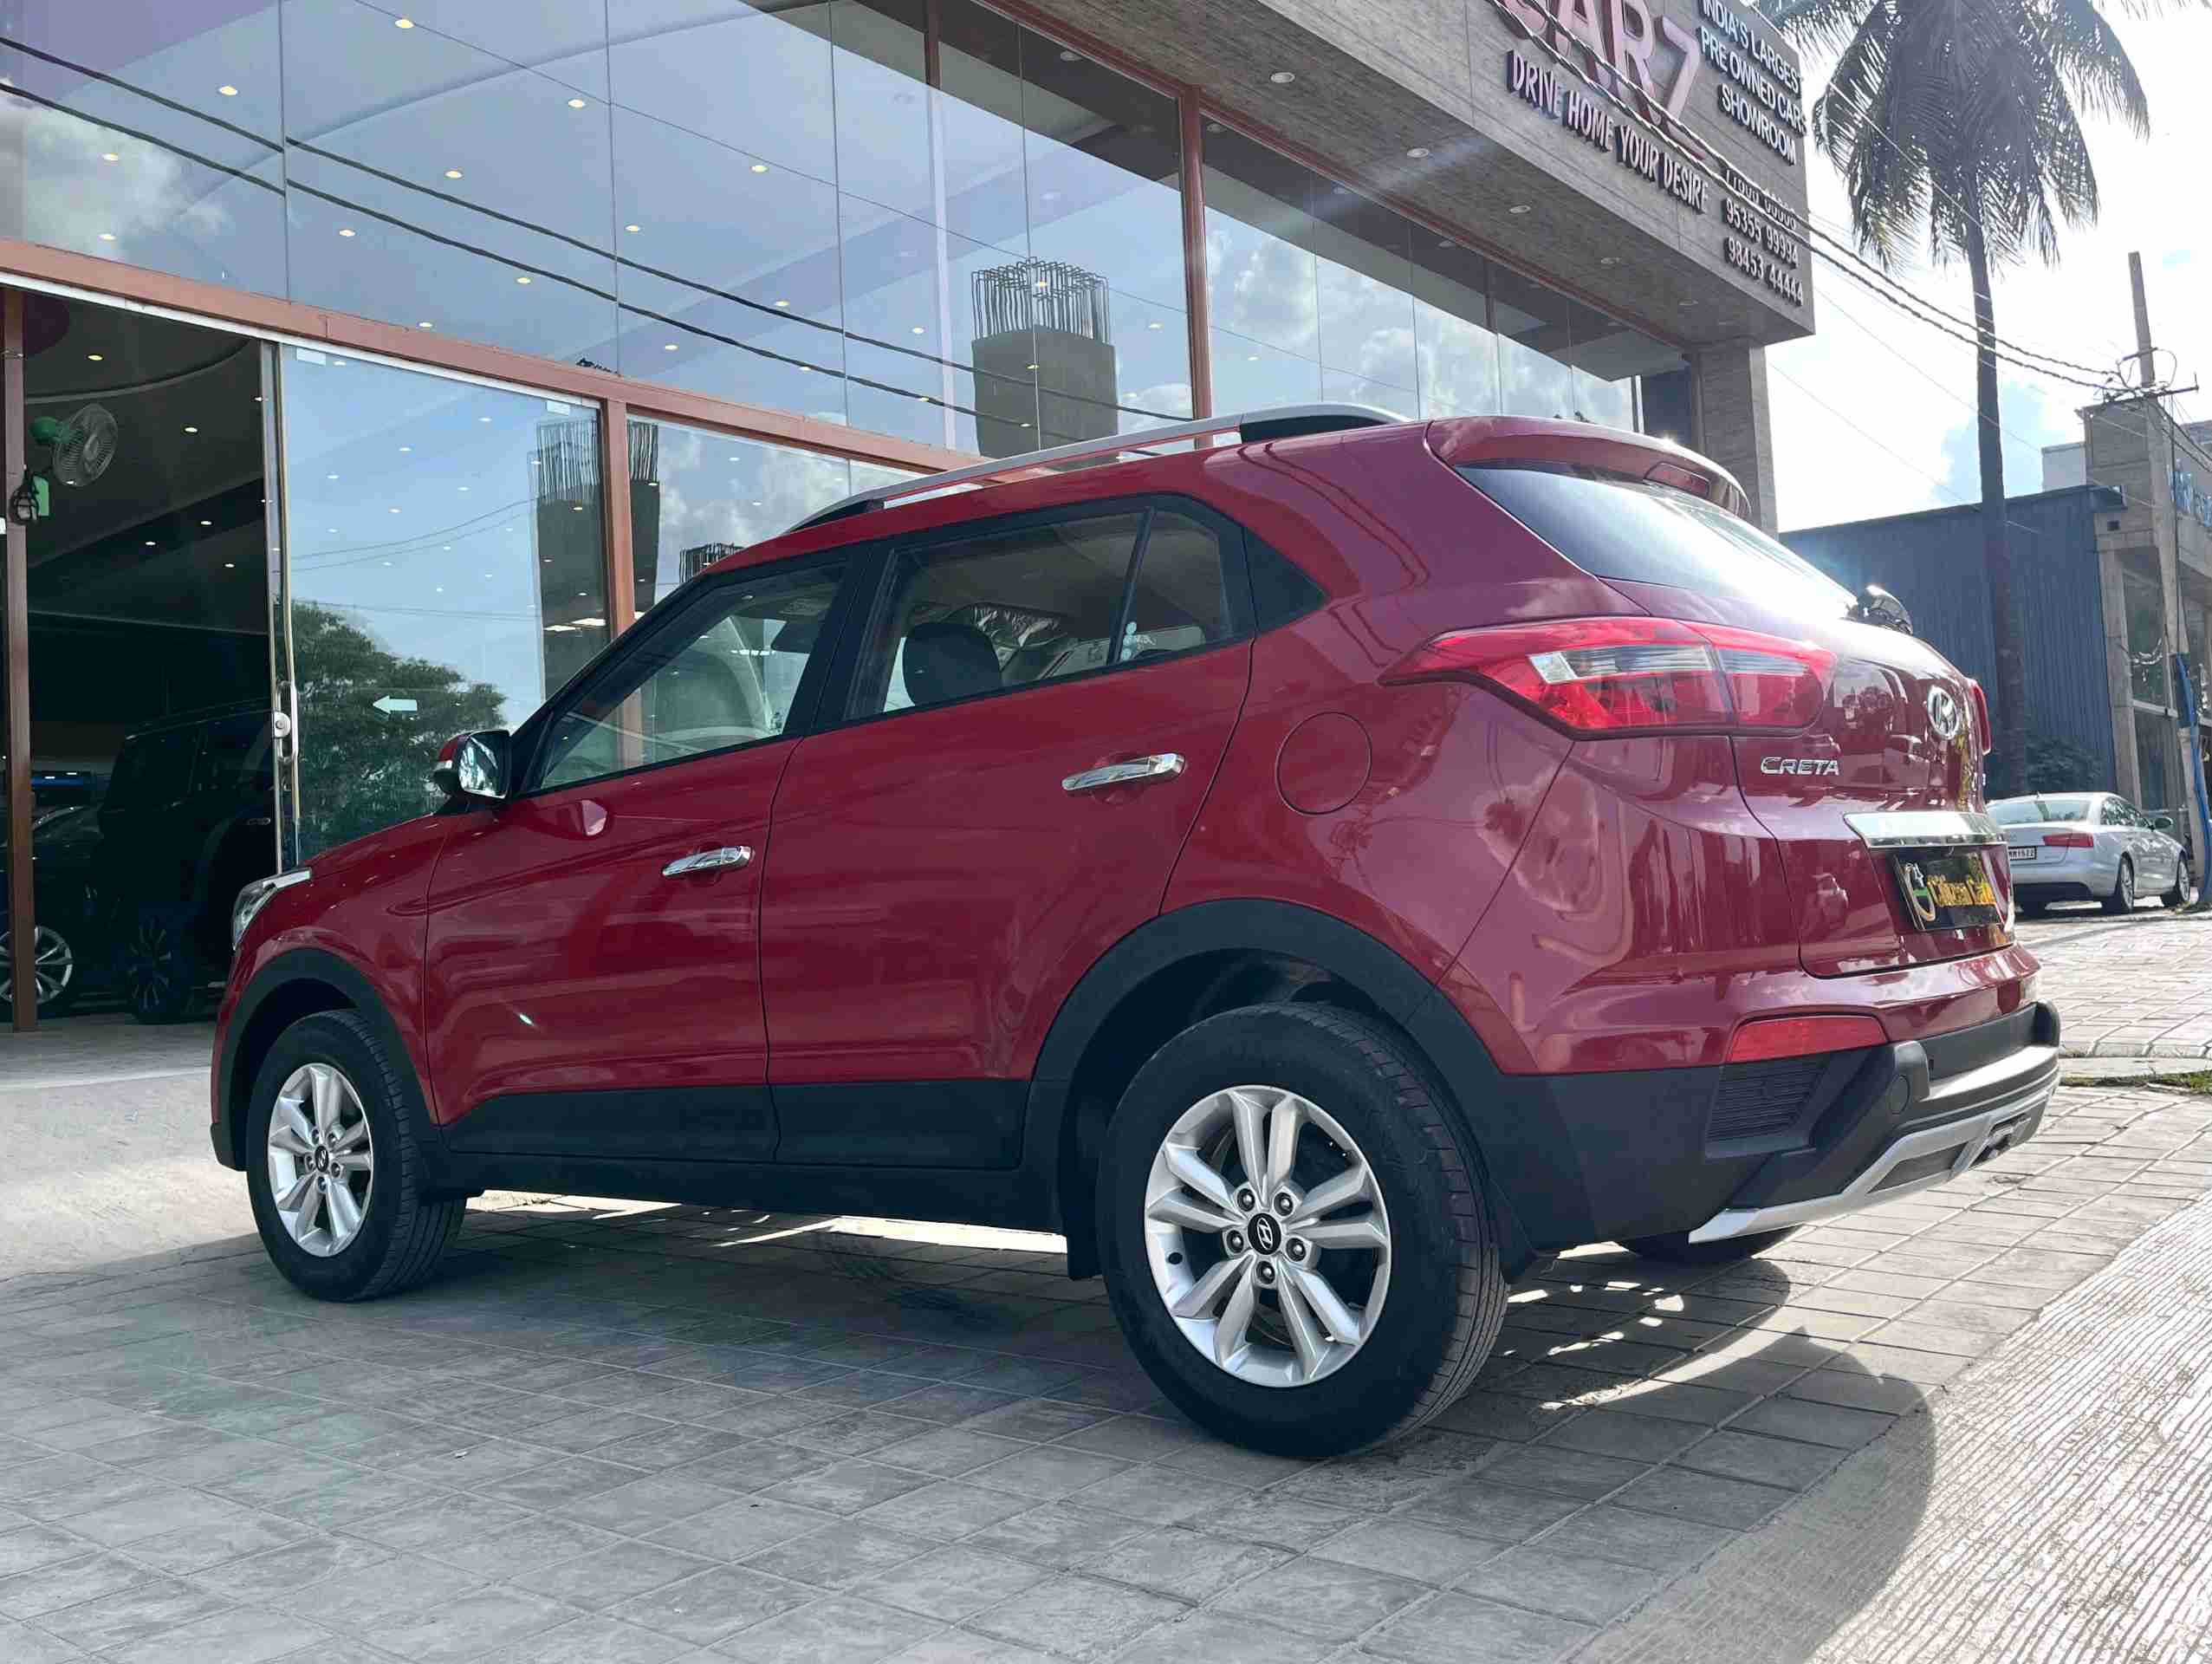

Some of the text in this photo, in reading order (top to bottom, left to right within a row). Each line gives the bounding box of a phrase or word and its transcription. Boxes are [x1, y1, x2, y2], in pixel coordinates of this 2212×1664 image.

[1499, 0, 1705, 159] AR7
[1701, 25, 1728, 73] PRE
[1729, 50, 1776, 111] OWNED
[1512, 50, 1562, 118] DRIVE
[1567, 89, 1613, 151] HOME
[1619, 124, 1659, 180] YOUR
[1664, 151, 1709, 213] DESIRE
[1722, 83, 1797, 166] SHOWROOM
[1726, 198, 1761, 244] 95355
[1766, 224, 1800, 269] 99994
[1729, 236, 1803, 306] 98453 44444
[1761, 757, 1839, 776] CRETA
